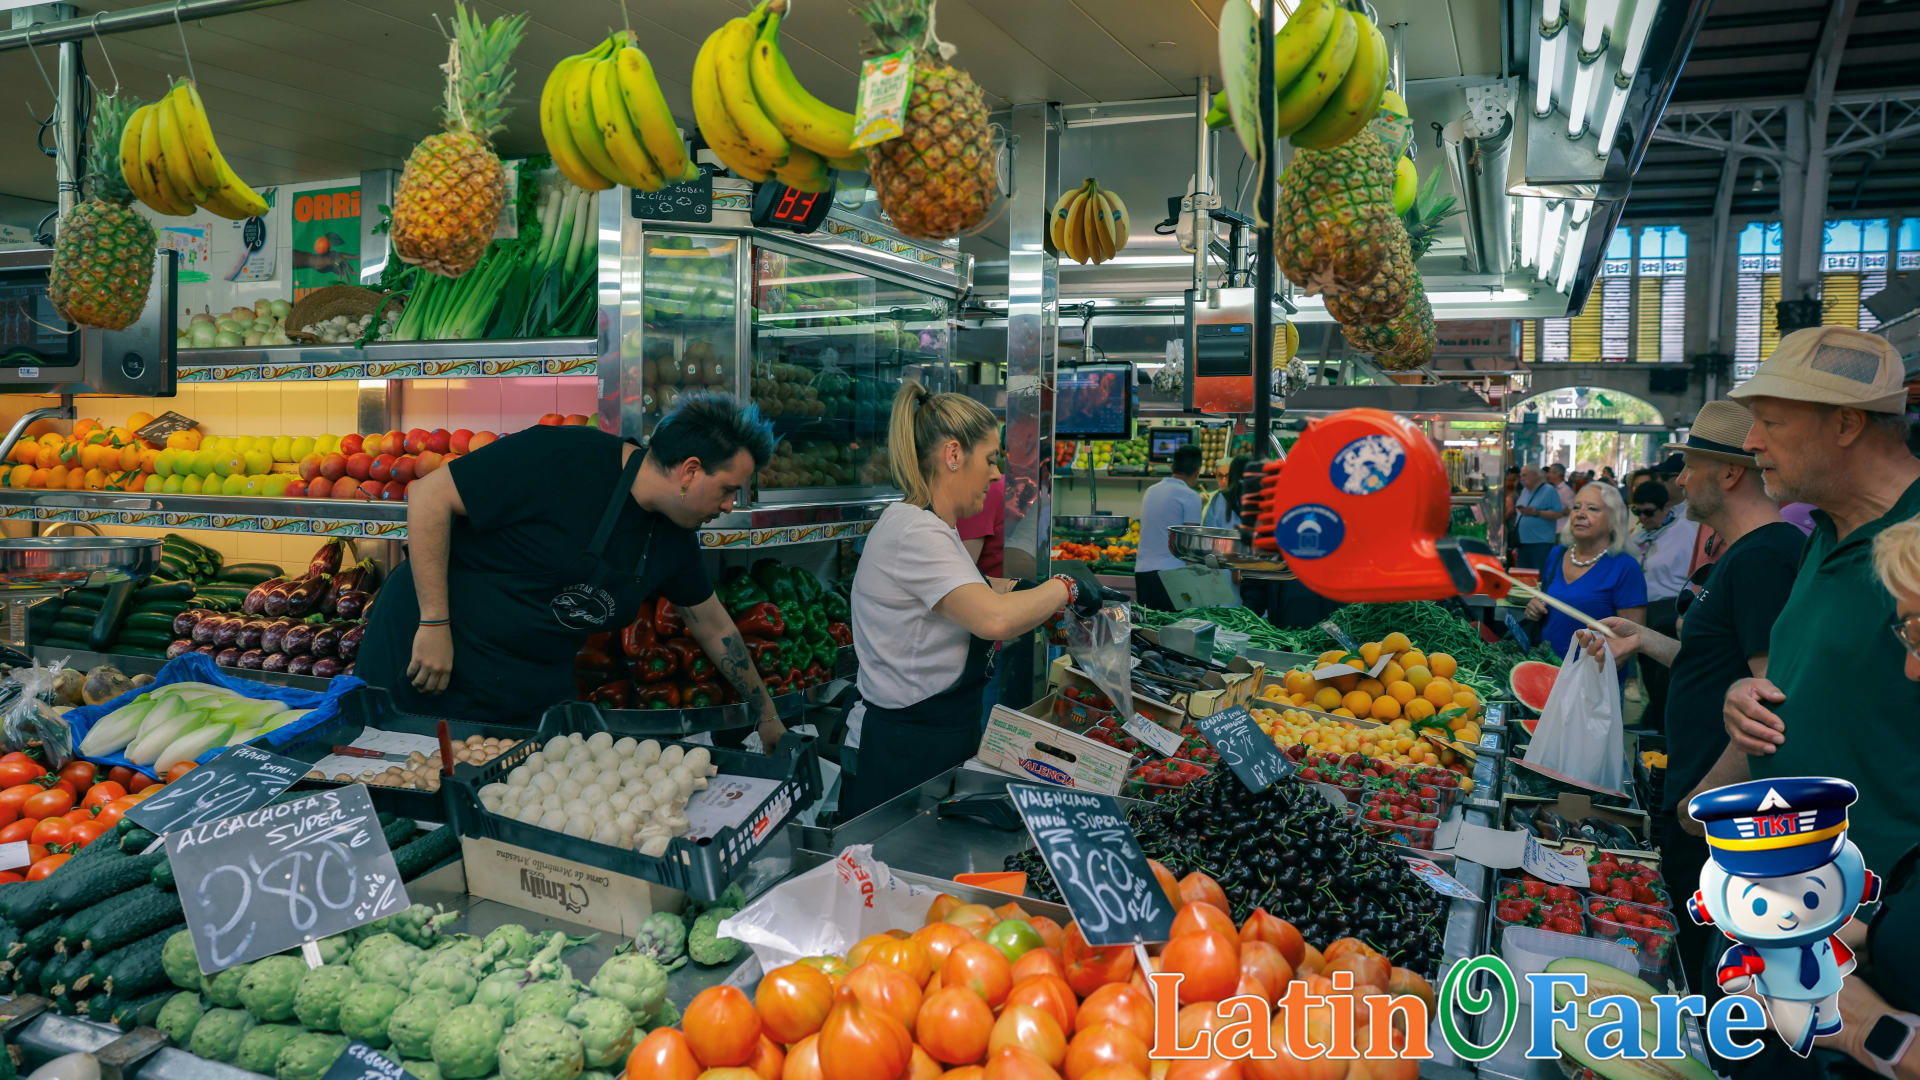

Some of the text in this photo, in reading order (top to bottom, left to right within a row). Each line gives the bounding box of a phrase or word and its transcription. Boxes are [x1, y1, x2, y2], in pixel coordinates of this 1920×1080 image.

[774, 185, 819, 222] 83
[1017, 757, 1076, 788] VALENCIA
[1018, 788, 1101, 809] VALENCIANO
[177, 791, 341, 854] ALCACHOFAS
[496, 849, 532, 866] Artesana
[532, 859, 574, 878] Membrillo
[574, 871, 585, 882] de
[520, 867, 567, 906] Emily
[585, 874, 609, 888] Carne
